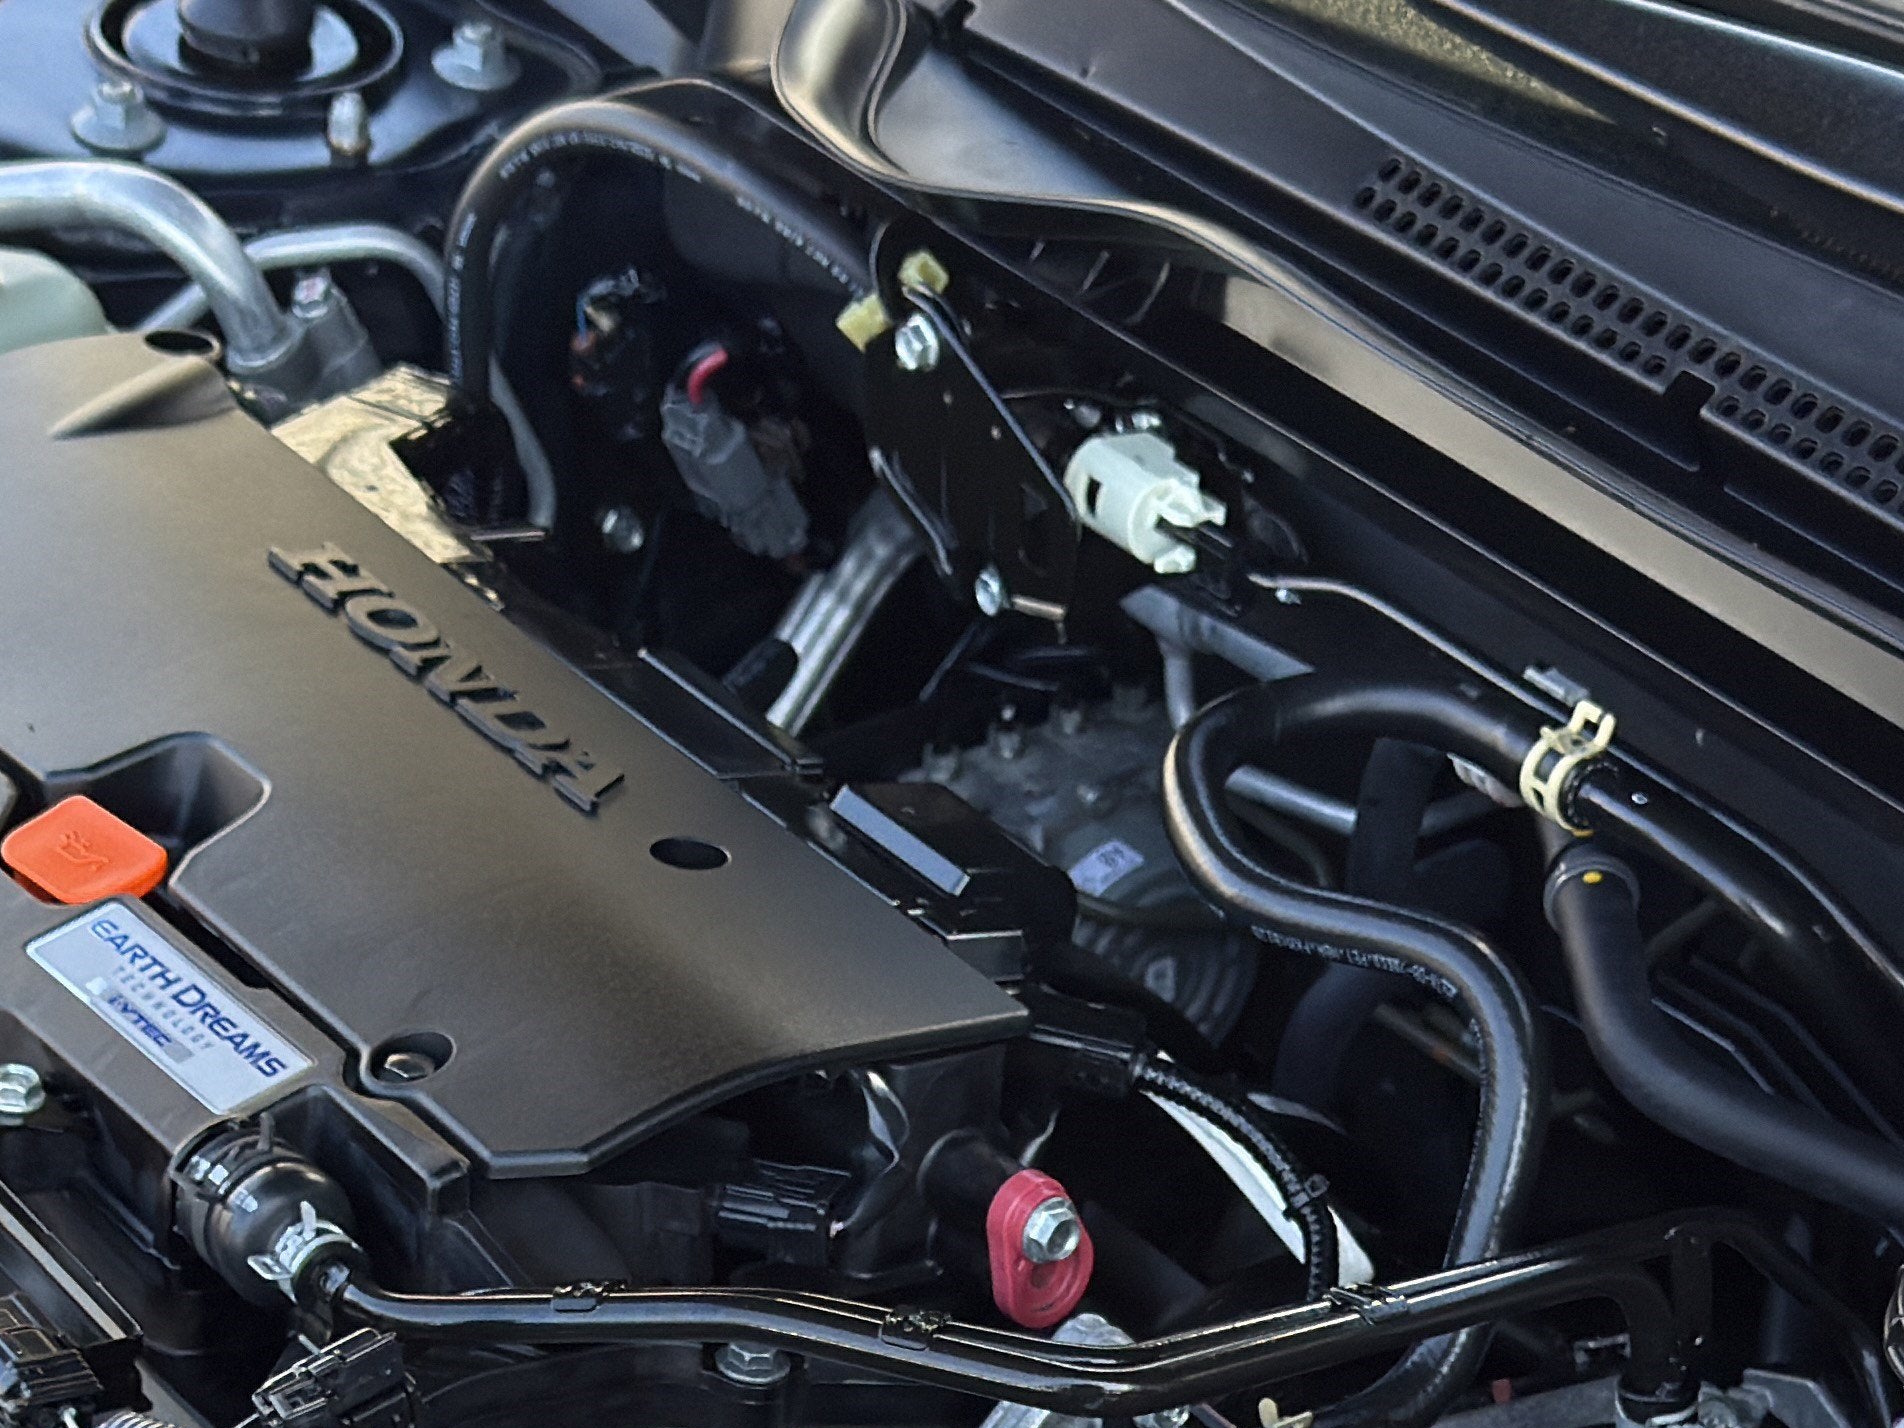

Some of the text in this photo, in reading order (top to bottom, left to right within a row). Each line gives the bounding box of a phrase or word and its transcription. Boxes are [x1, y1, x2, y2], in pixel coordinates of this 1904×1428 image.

[267, 541, 625, 818] HONDA
[91, 919, 287, 1077] EARTH DREAMS
